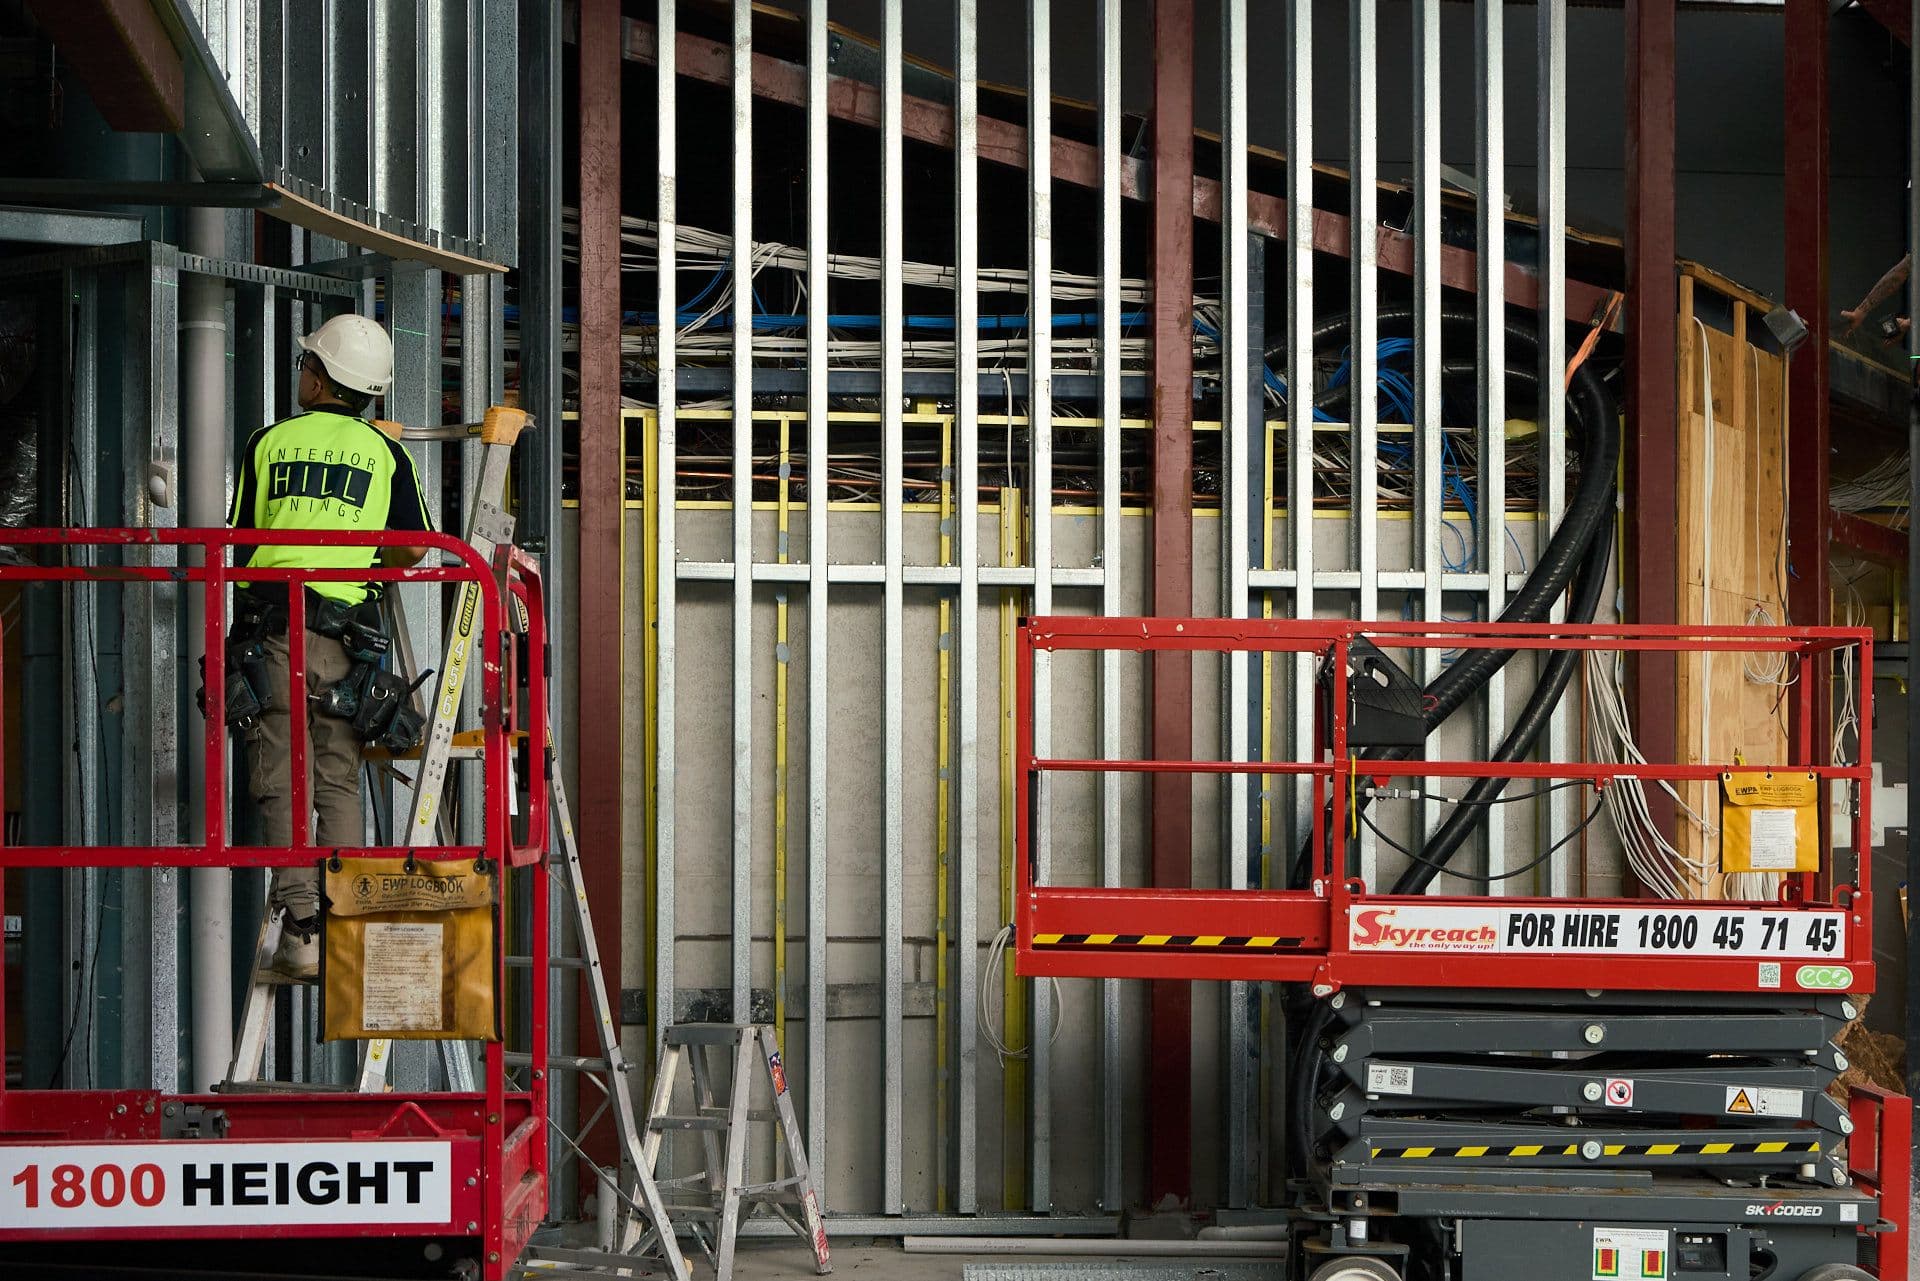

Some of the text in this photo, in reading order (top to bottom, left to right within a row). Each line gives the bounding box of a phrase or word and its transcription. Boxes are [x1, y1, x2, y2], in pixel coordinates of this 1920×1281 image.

[268, 448, 376, 472] INTERIOR
[274, 465, 356, 502] HILL
[267, 498, 362, 523] LININGS
[382, 878, 464, 894] EWP LOGBOOK
[1353, 909, 1838, 952] Skyreach FOR HIRE 1800 45 71 45
[1800, 968, 1849, 986] eco
[12, 1161, 434, 1209] 1800 HEIGHT
[1745, 1200, 1823, 1217] SKYCODED
